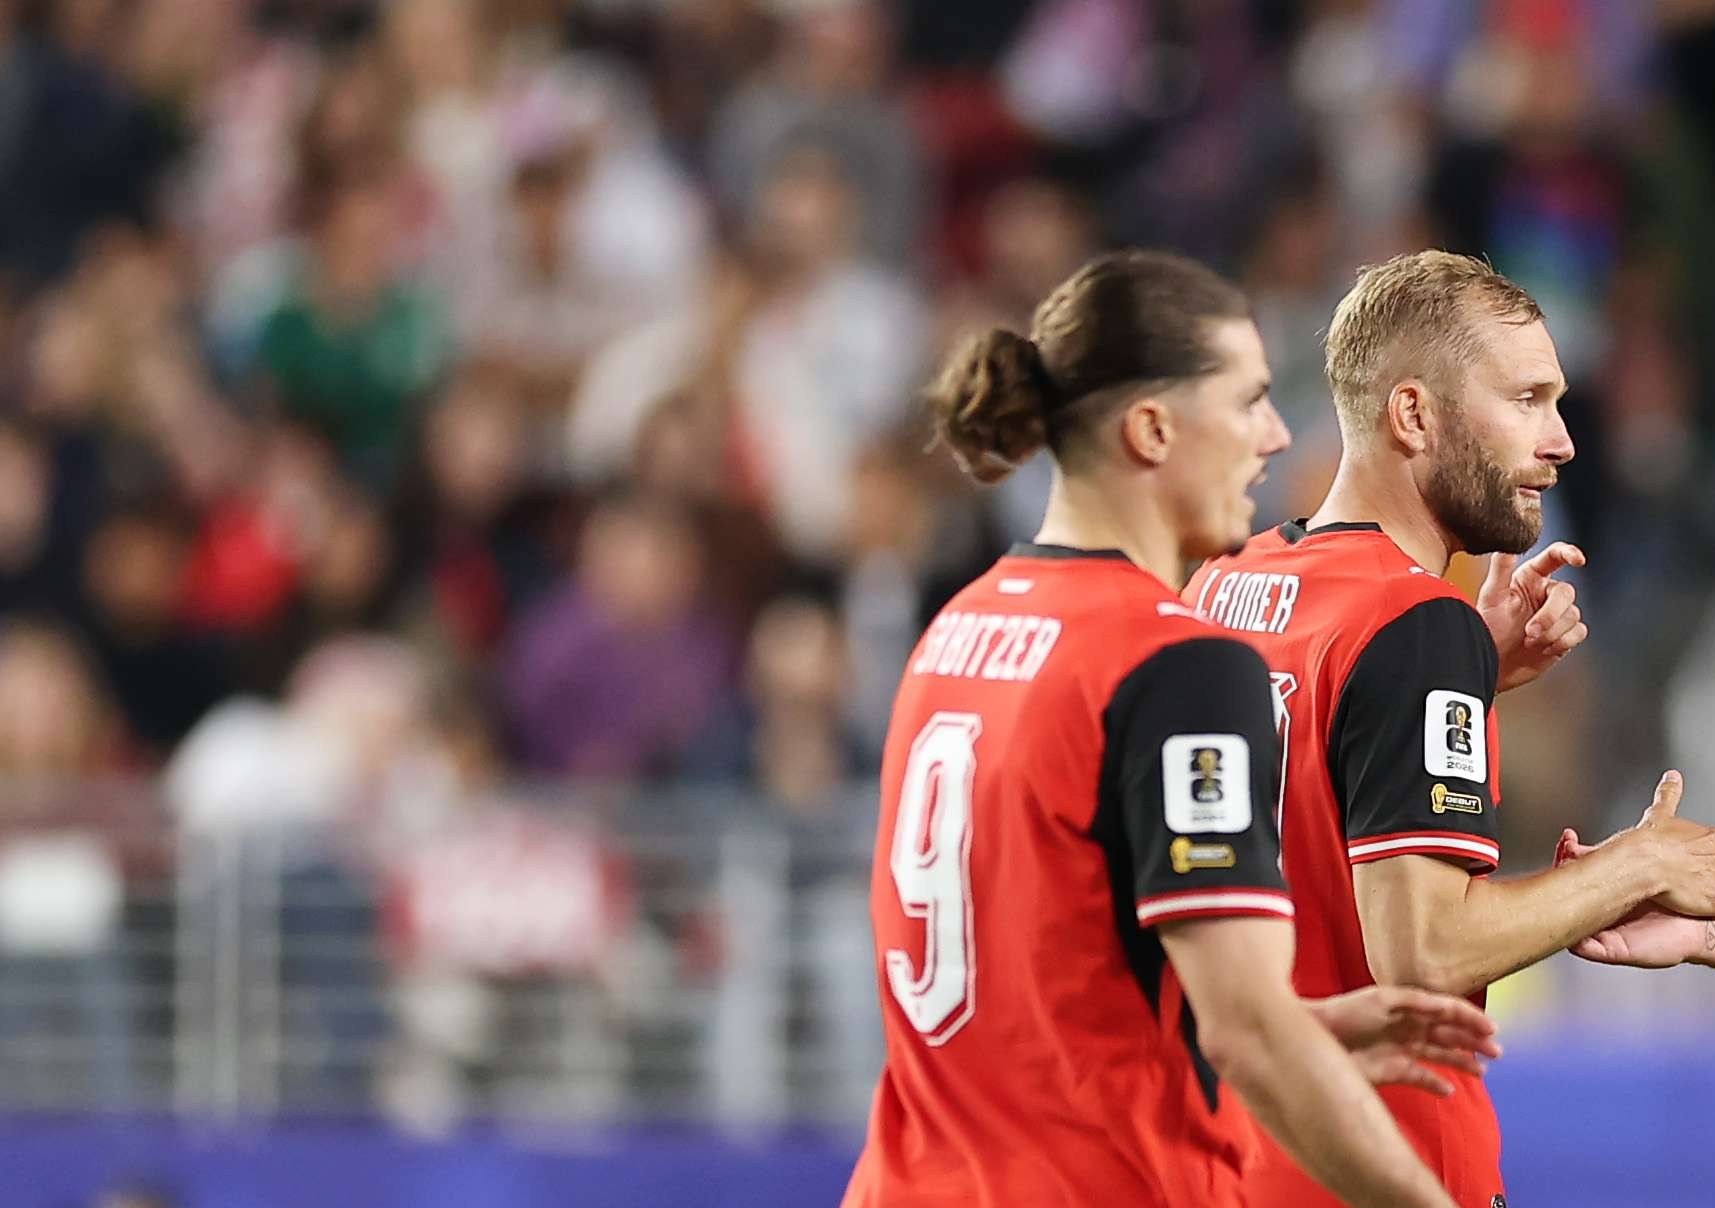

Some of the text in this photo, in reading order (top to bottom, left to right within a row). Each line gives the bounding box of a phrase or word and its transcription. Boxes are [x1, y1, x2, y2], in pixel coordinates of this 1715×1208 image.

[1194, 568, 1300, 634] LAIMER
[1445, 796, 1478, 807] DEBUT
[885, 710, 982, 1047] 9
